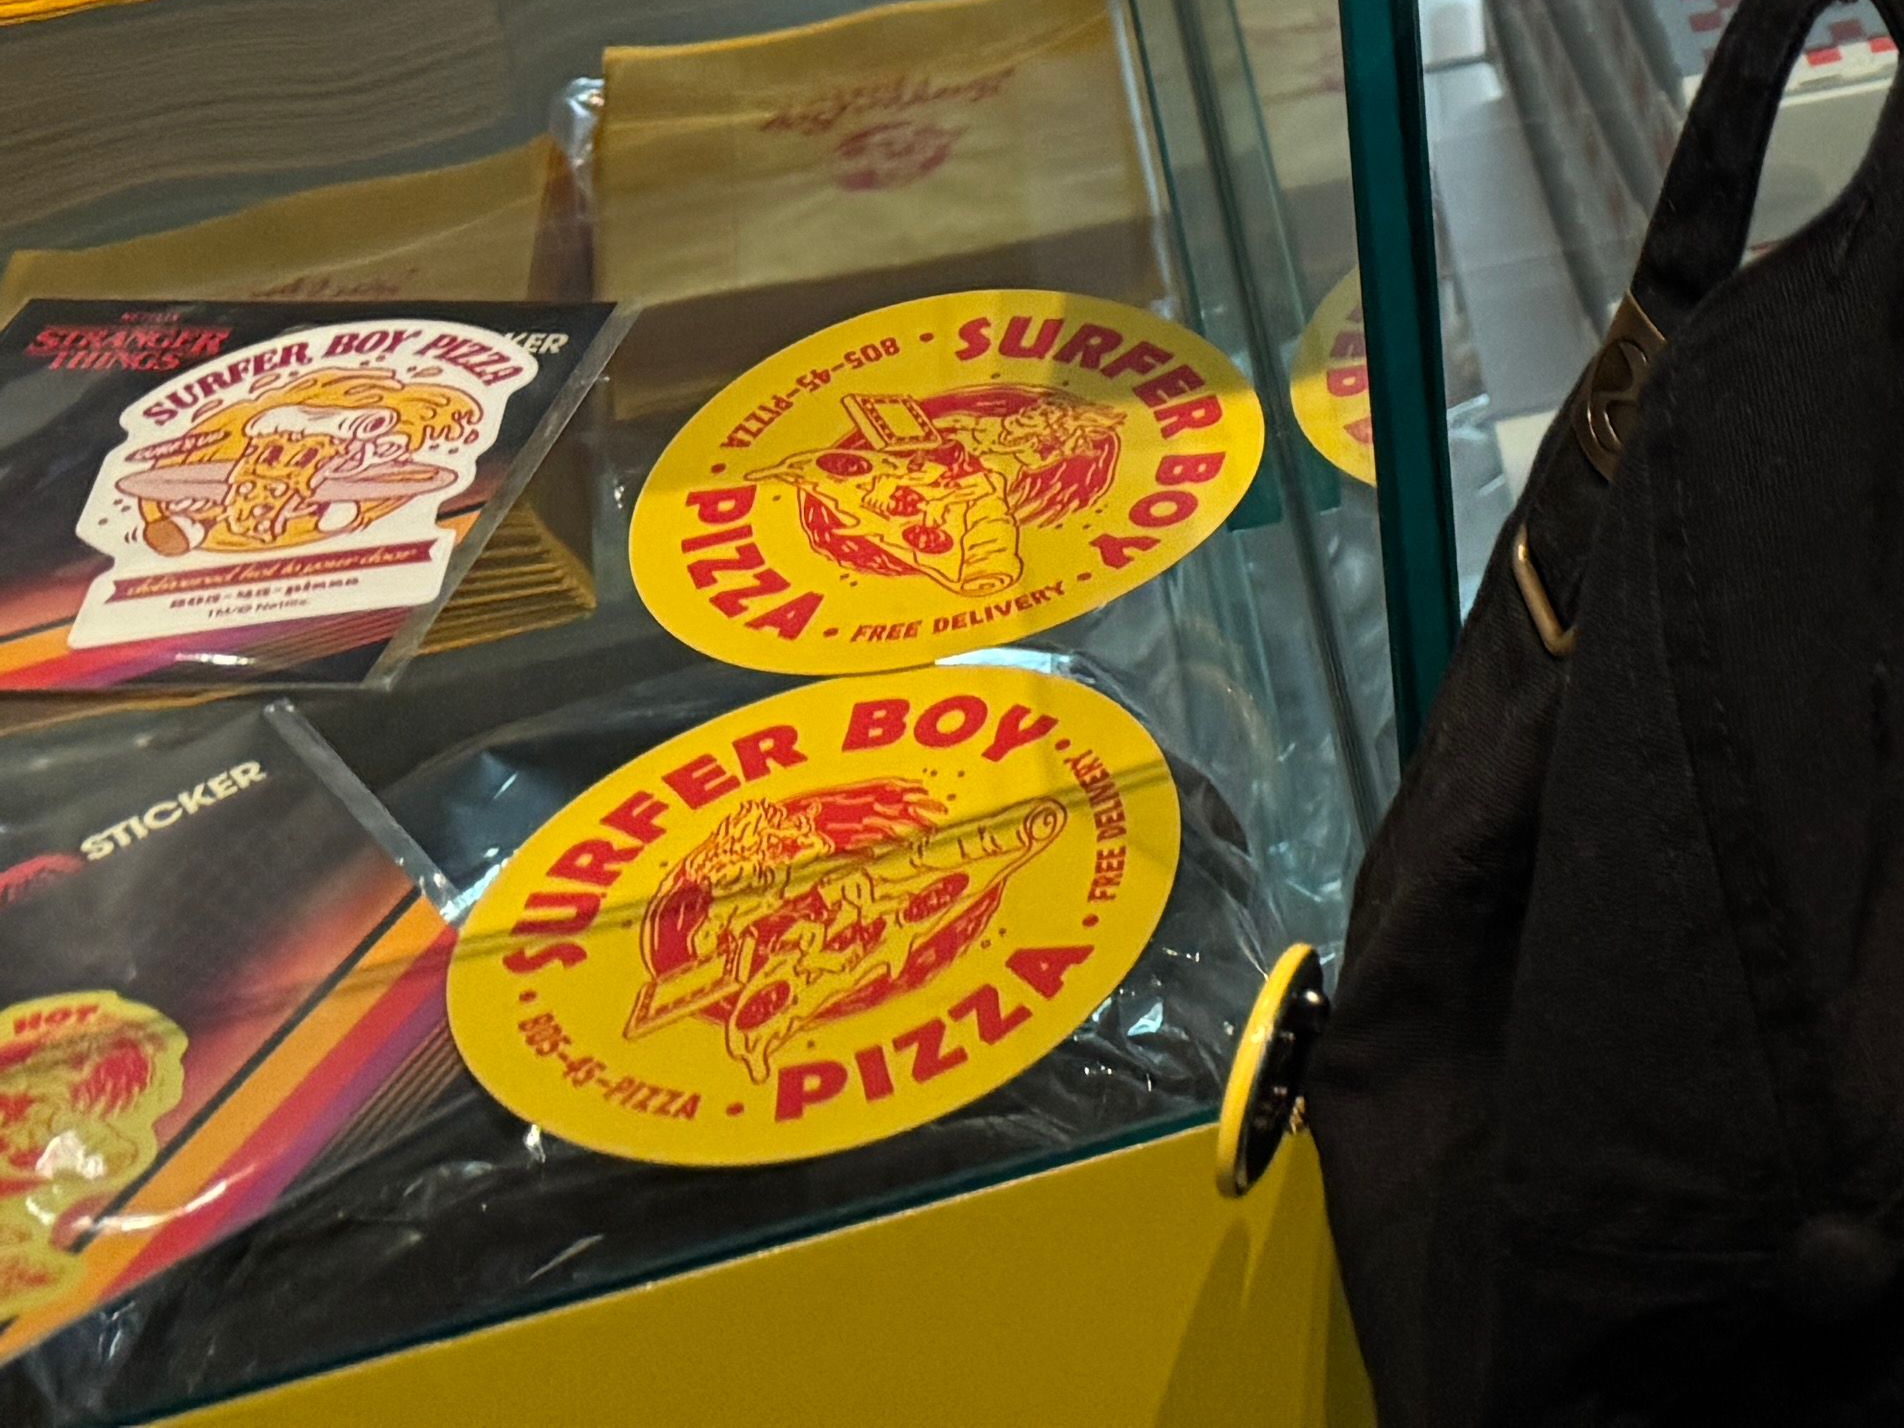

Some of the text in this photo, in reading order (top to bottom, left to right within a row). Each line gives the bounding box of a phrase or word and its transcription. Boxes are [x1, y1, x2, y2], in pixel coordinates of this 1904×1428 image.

[49, 348, 182, 372] THINGS
[143, 342, 312, 426] SURFER
[320, 329, 418, 360] BOY
[415, 329, 525, 388] PIZZA
[954, 315, 1227, 572] SURFER BOY
[680, 484, 826, 641] PIZZA
[850, 581, 1065, 644] FREE DELIVERY
[79, 759, 268, 862] STICKER
[501, 693, 1058, 976] SURFER BOY
[1064, 747, 1127, 903] FREE DELIVERY
[12, 1003, 100, 1036] HOT
[774, 943, 1095, 1124] PIZZA
